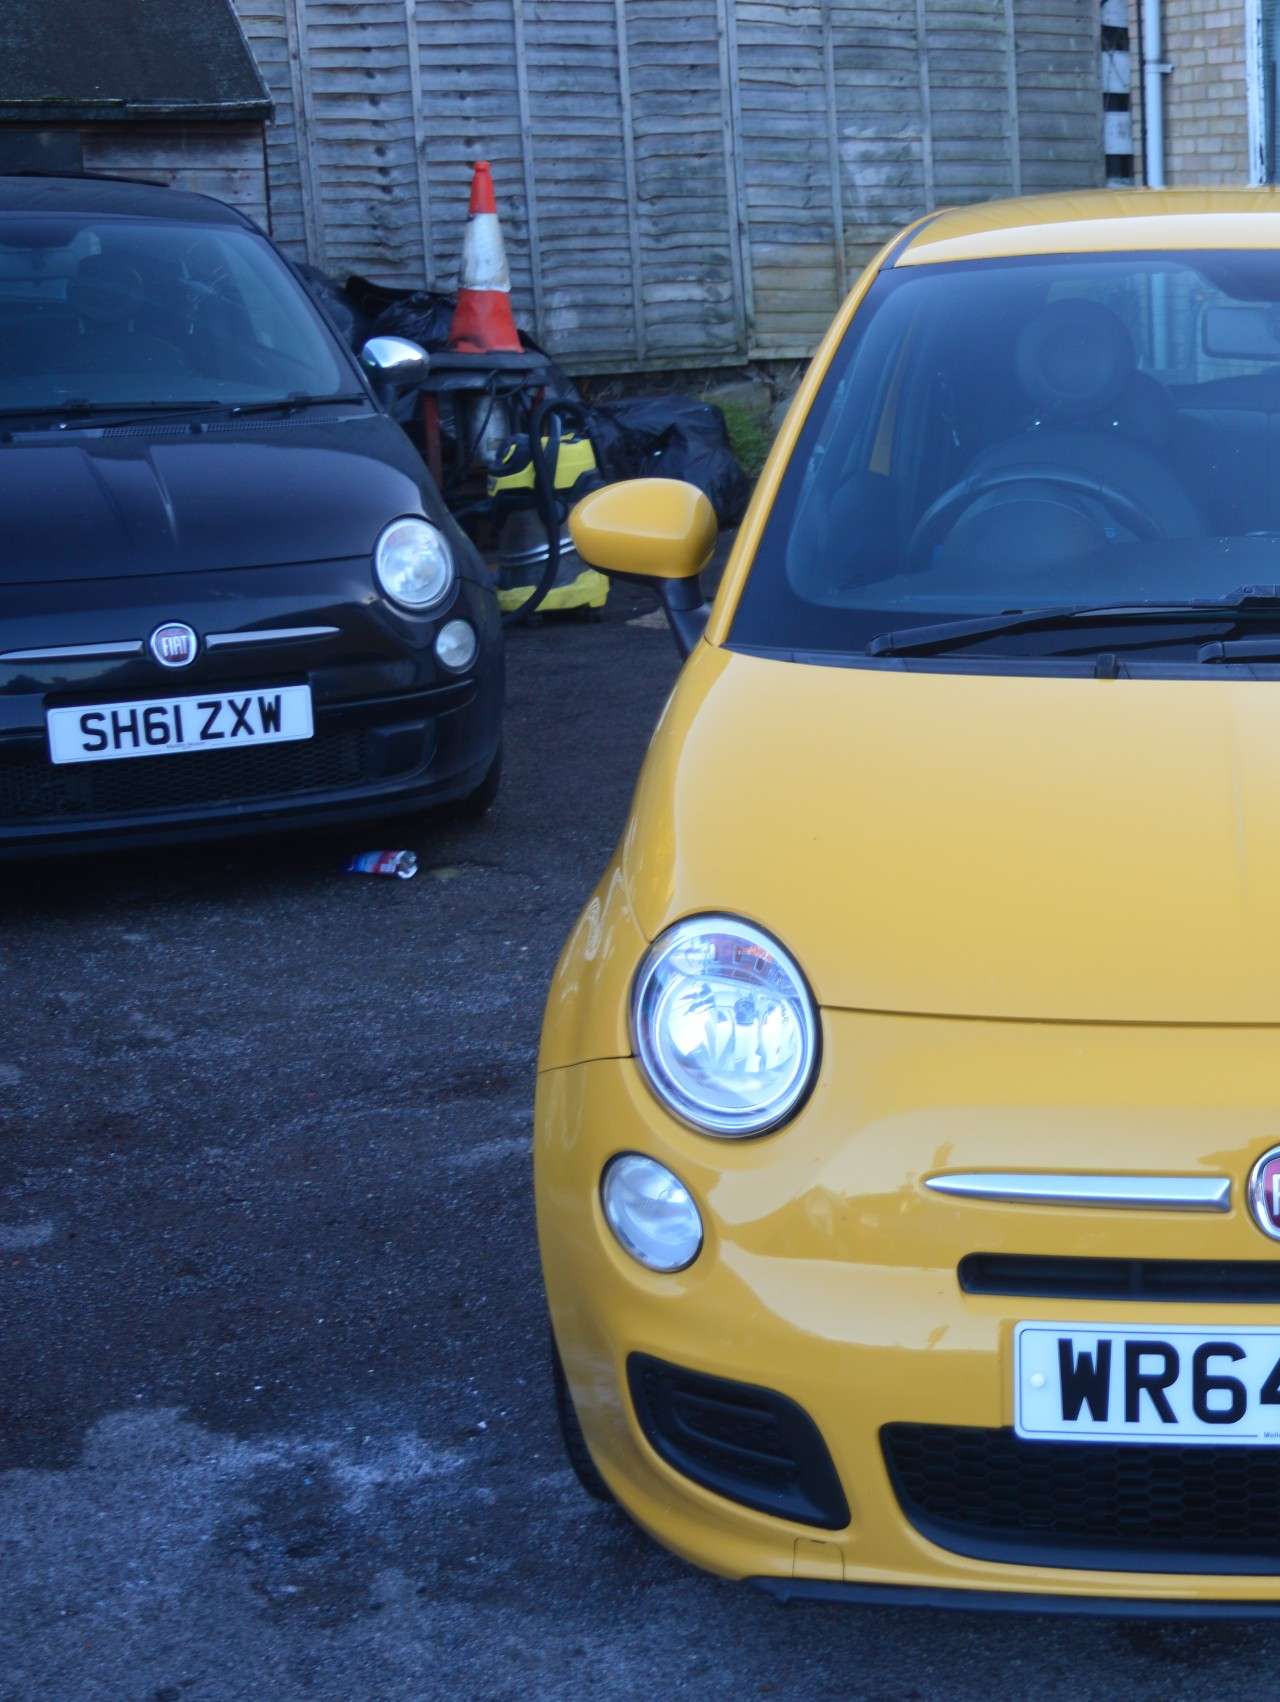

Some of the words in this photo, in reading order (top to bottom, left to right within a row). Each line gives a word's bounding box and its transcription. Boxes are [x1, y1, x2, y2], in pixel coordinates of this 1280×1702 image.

[161, 634, 188, 657] FIAT
[79, 703, 184, 752] SH61
[197, 694, 283, 741] ZXW
